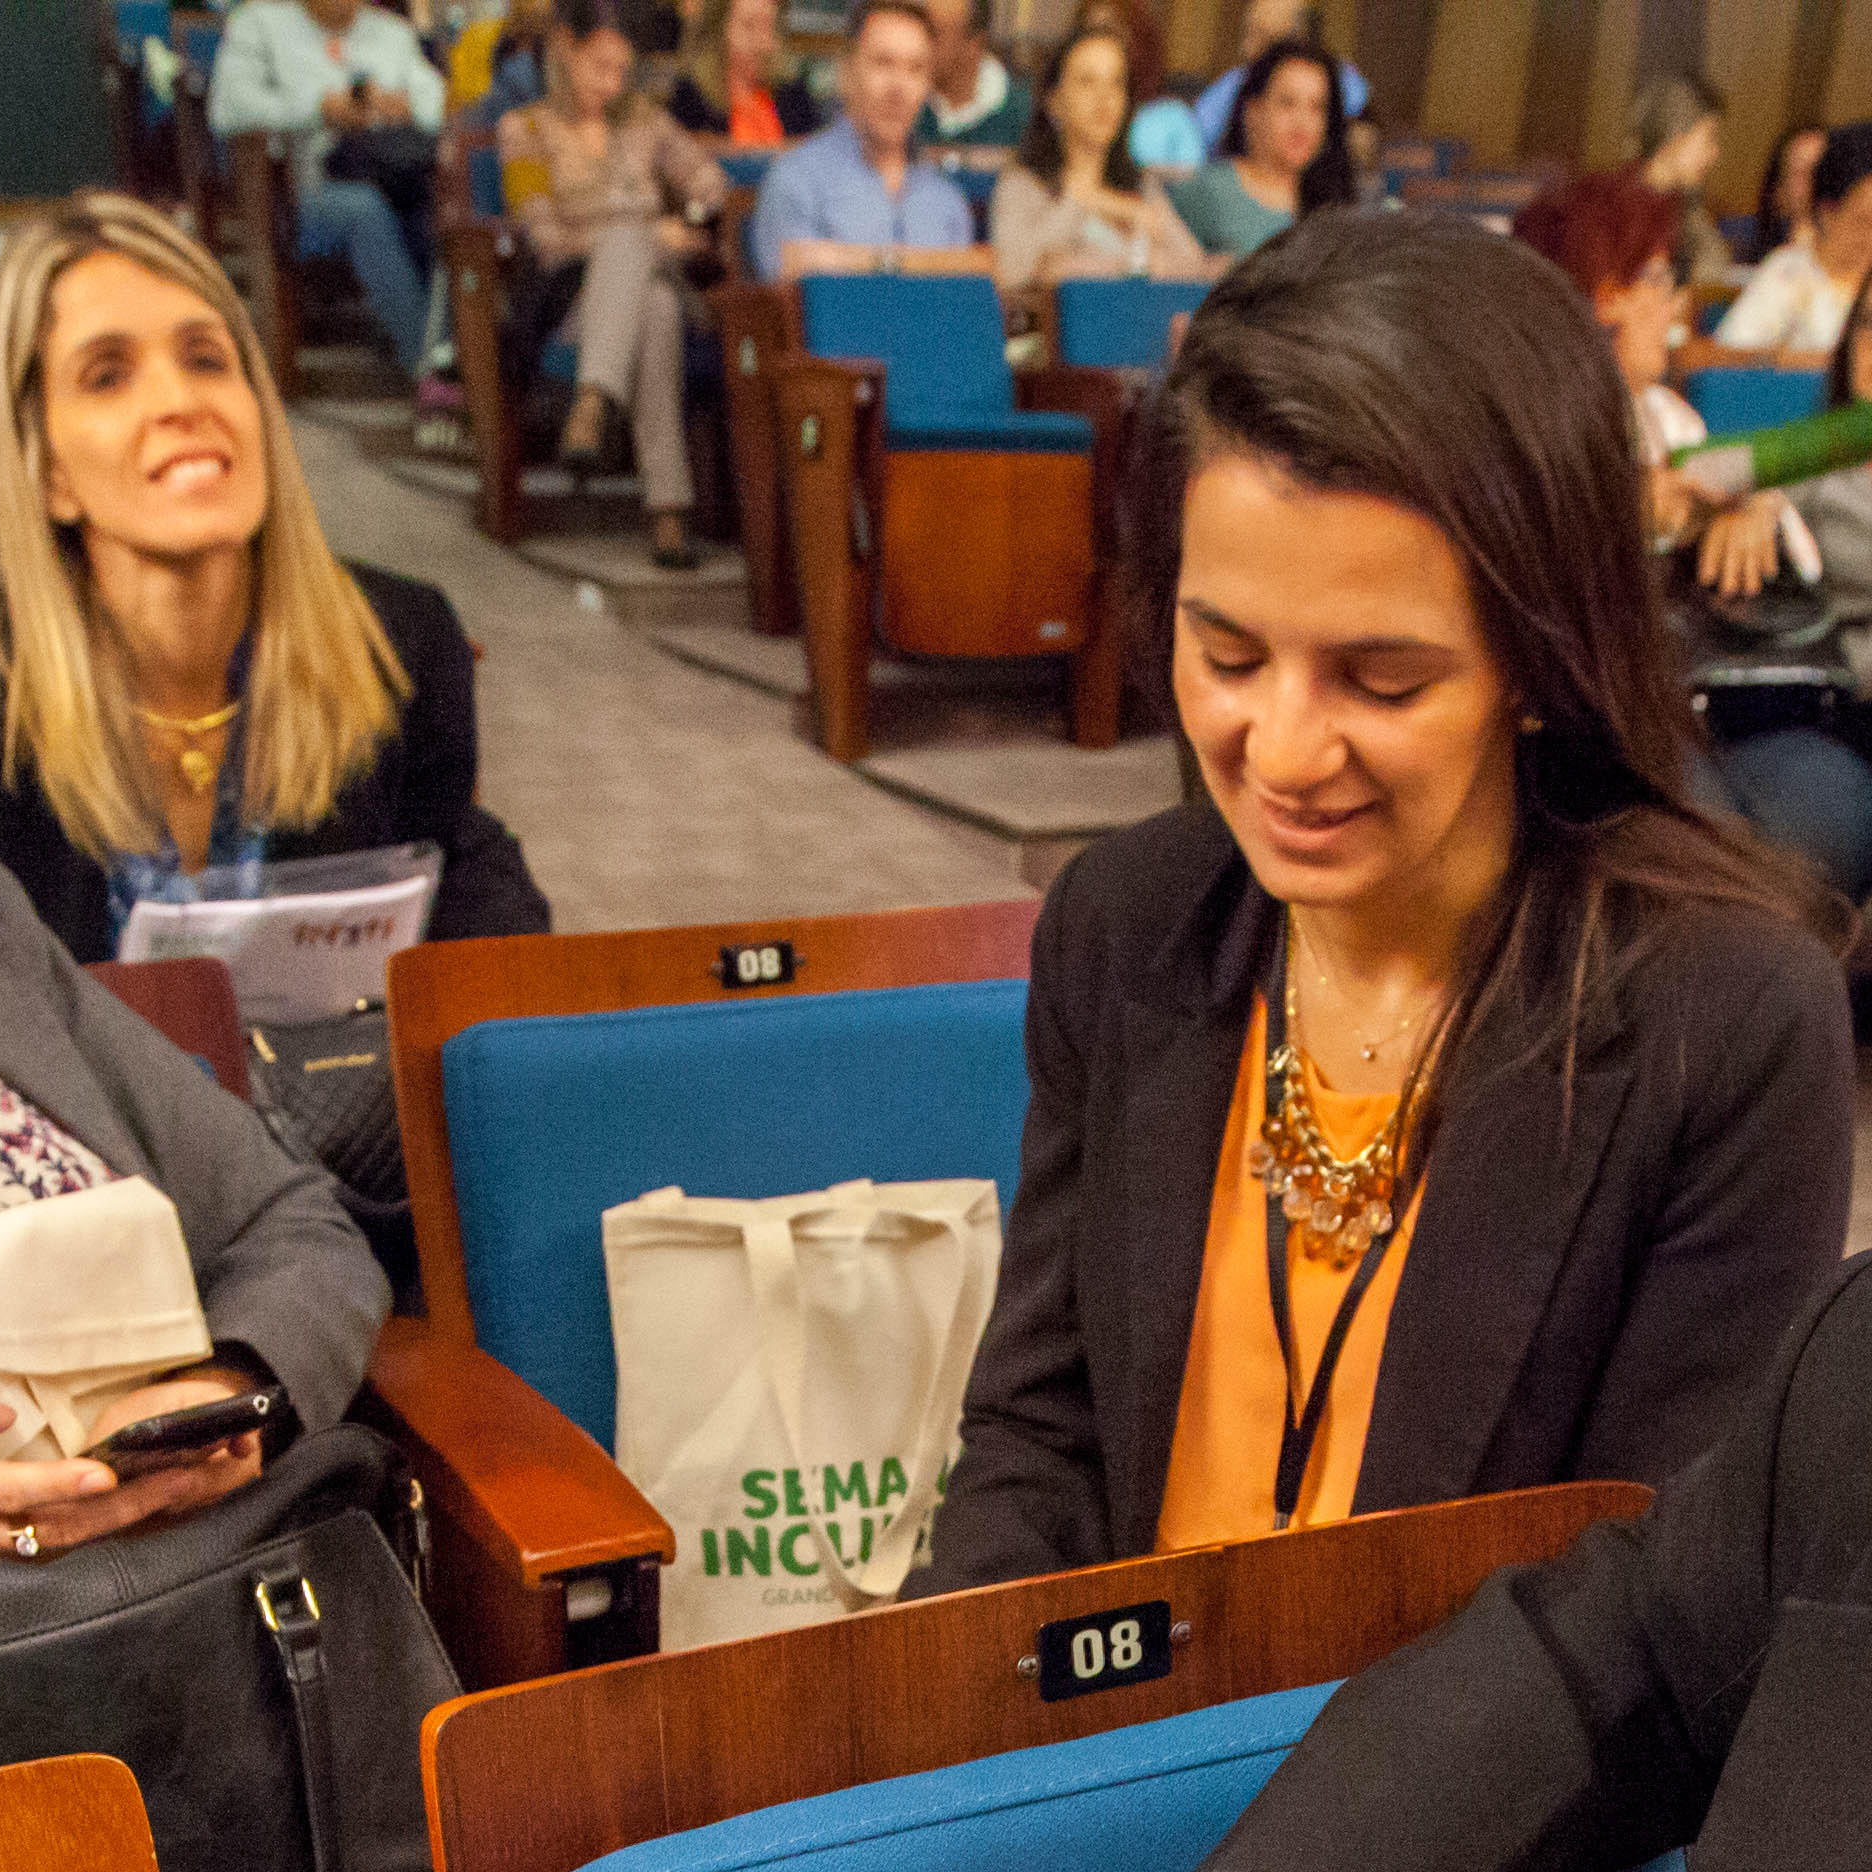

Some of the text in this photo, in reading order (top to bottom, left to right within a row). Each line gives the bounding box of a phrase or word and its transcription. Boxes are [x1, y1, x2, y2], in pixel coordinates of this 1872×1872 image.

[737, 946, 781, 983] 08
[741, 1456, 946, 1519] SEMA
[1071, 1618, 1144, 1680] 08
